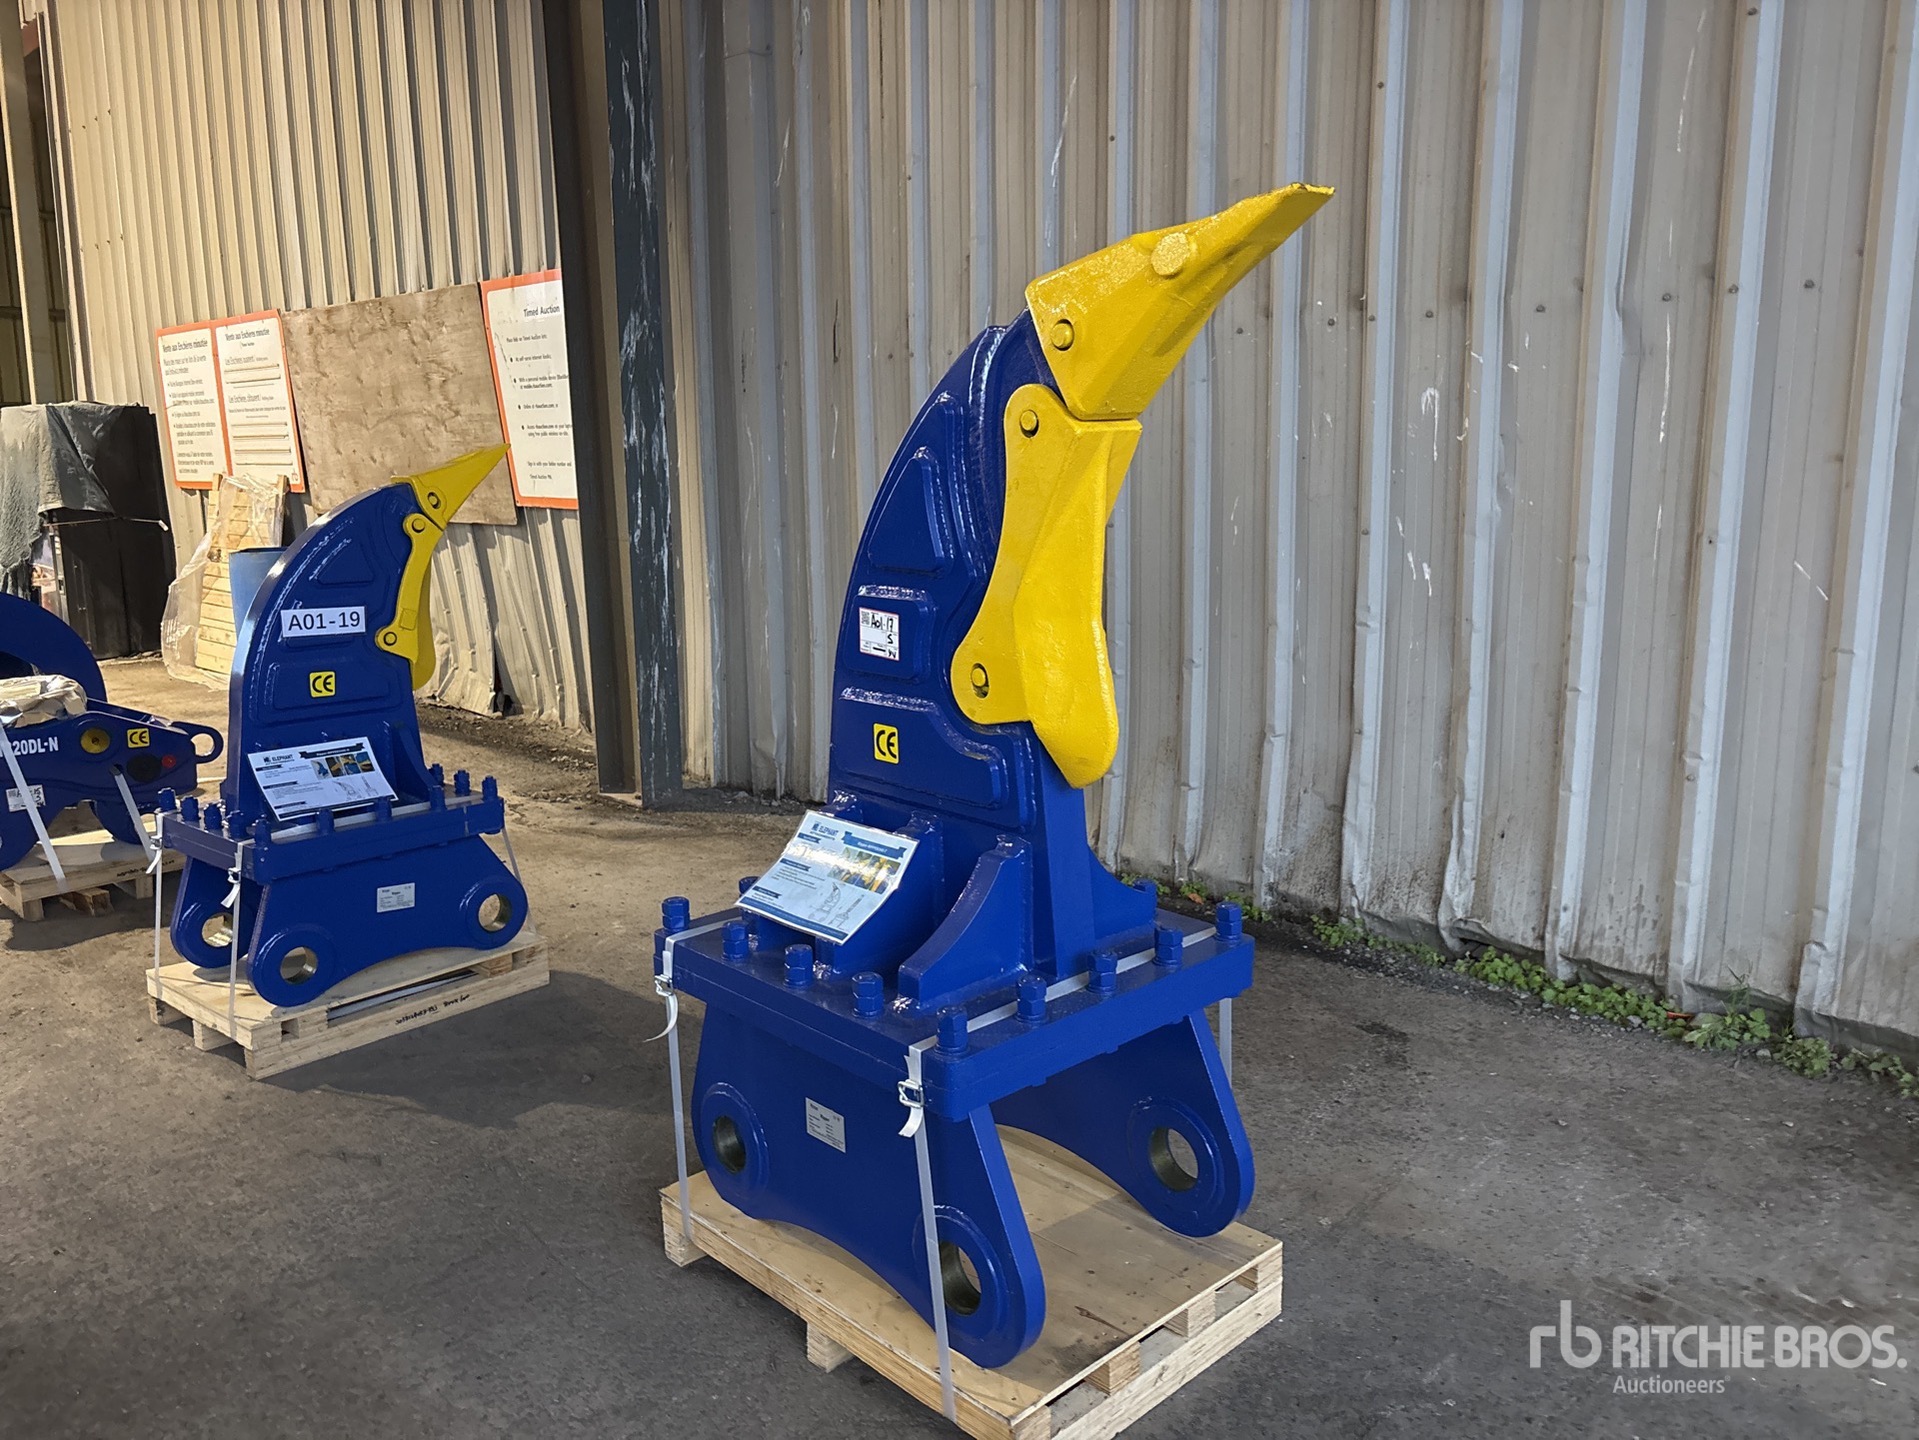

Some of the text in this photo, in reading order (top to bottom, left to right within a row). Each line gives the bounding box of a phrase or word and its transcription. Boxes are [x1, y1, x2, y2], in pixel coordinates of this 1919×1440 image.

[524, 304, 560, 317] Timed Auction
[288, 611, 361, 632] A01-19
[312, 674, 334, 693] CE
[130, 730, 149, 745] CE
[876, 730, 897, 759] CE
